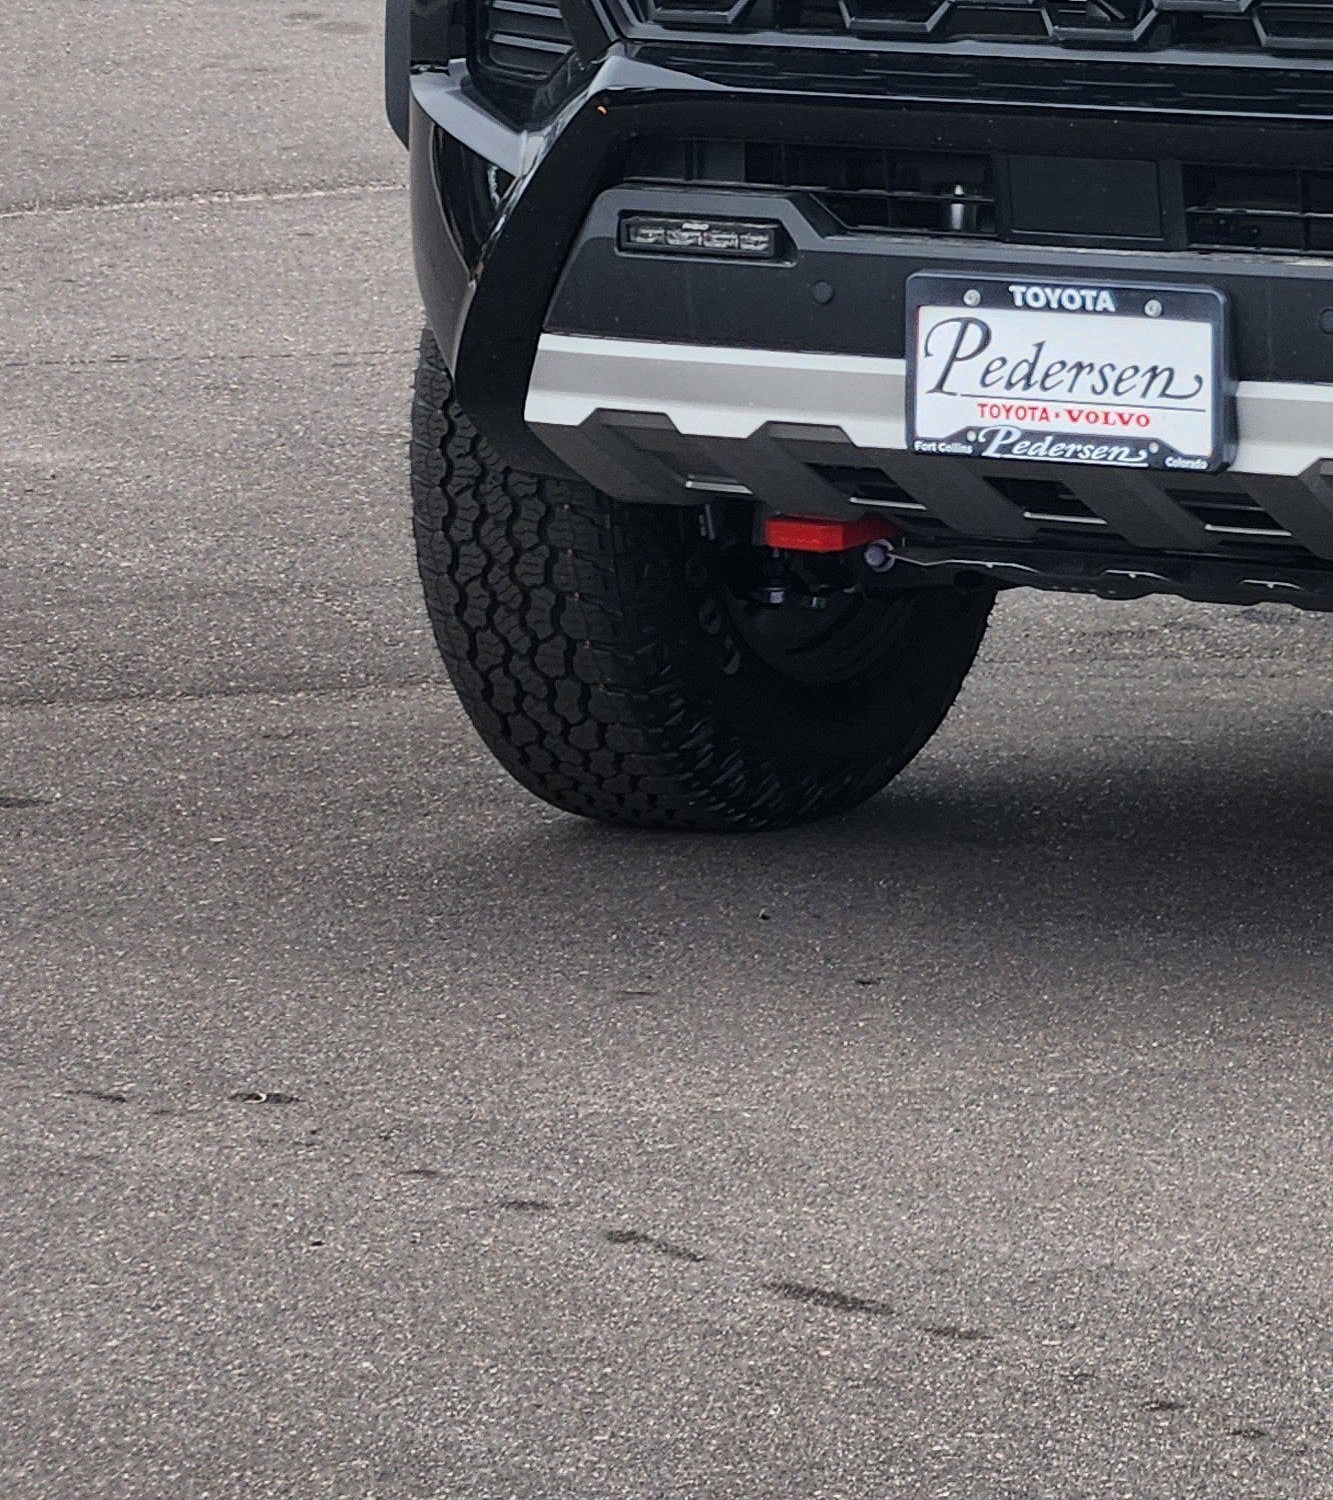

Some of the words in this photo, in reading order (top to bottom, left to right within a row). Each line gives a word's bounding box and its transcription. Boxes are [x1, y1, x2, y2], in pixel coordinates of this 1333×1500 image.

[1007, 284, 1117, 313] TOYOTA
[923, 316, 1204, 400] Pedersen
[977, 402, 1051, 423] TOYOTA
[1065, 408, 1152, 428] VOLVO
[913, 440, 938, 453] Fort
[938, 441, 974, 455] Collins
[977, 425, 1149, 464] Pedersen
[1164, 456, 1209, 470] Colorado
